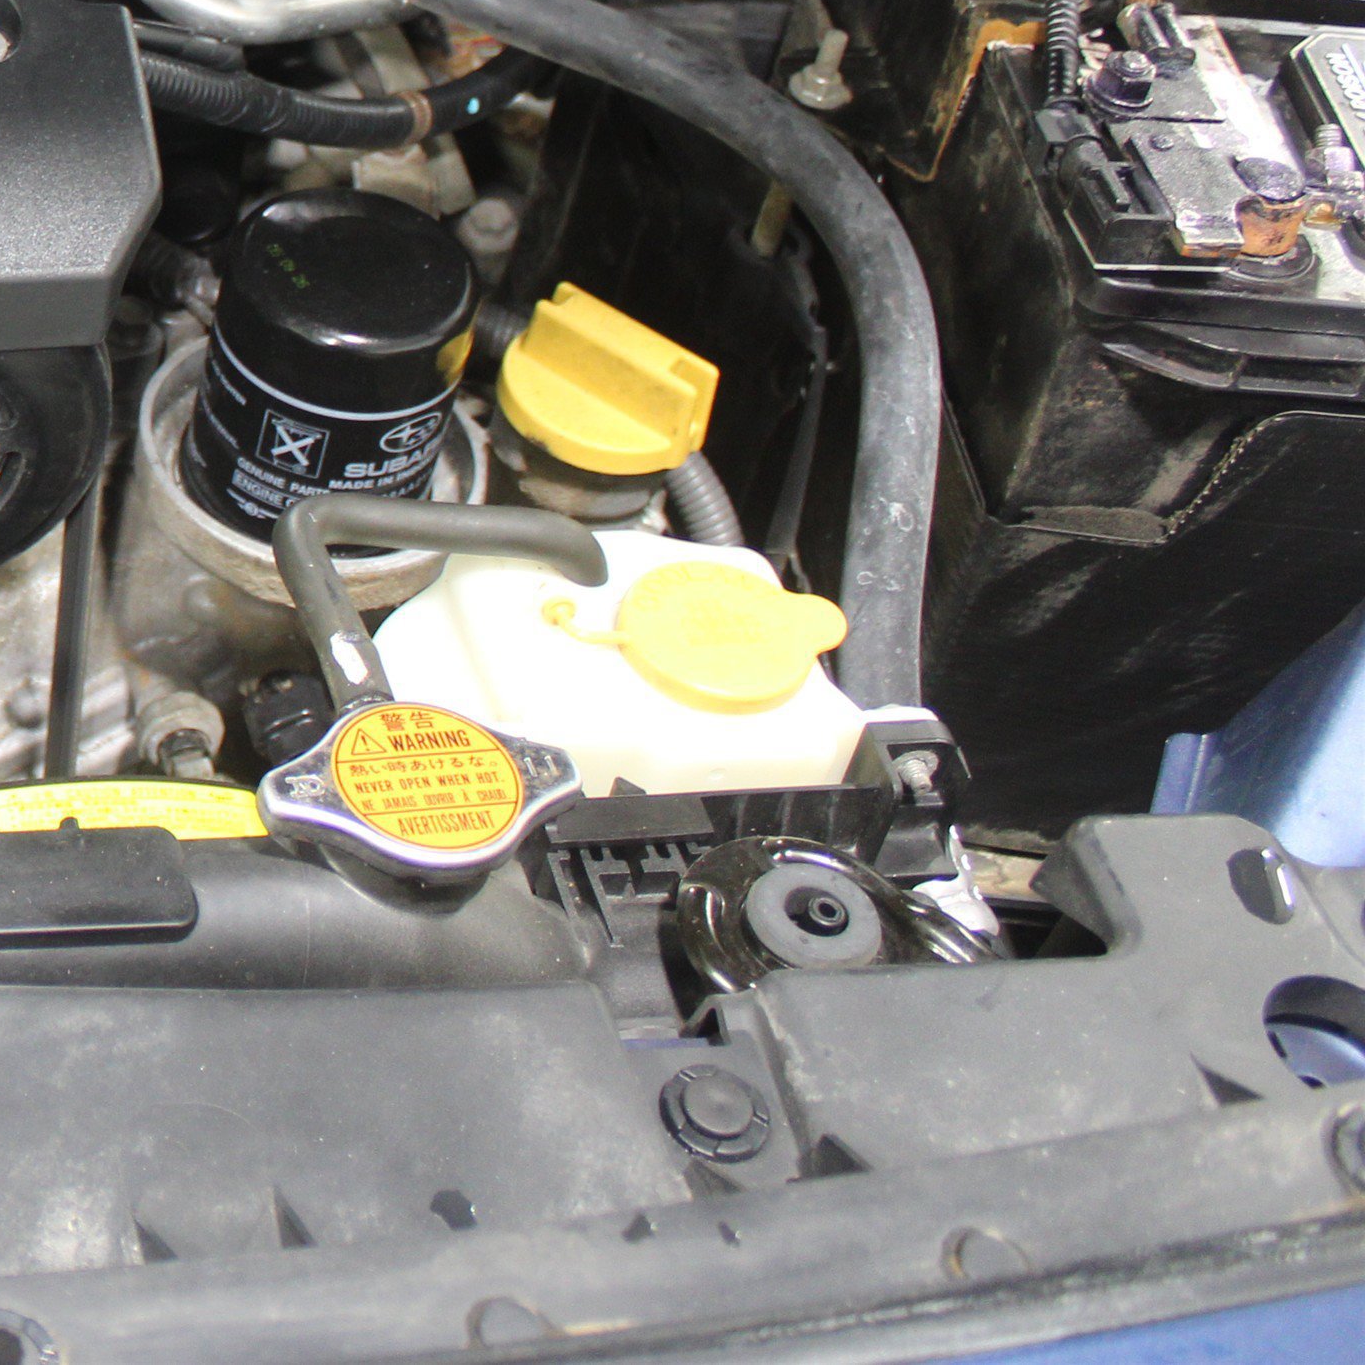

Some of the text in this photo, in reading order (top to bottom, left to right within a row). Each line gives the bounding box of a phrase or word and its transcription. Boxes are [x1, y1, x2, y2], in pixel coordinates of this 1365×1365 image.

[236, 455, 286, 489] GENUINE
[328, 474, 394, 490] MADE IN
[234, 473, 283, 506] ENGINE
[379, 710, 435, 732] 警告
[387, 729, 471, 753] WARNING
[354, 770, 506, 795] NEVER OPEN WHEN HOT.
[361, 799, 377, 812] NE
[383, 794, 418, 811] JAMAIS
[424, 791, 455, 806] OUVRIR
[397, 810, 497, 837] AVERTISSMENT
